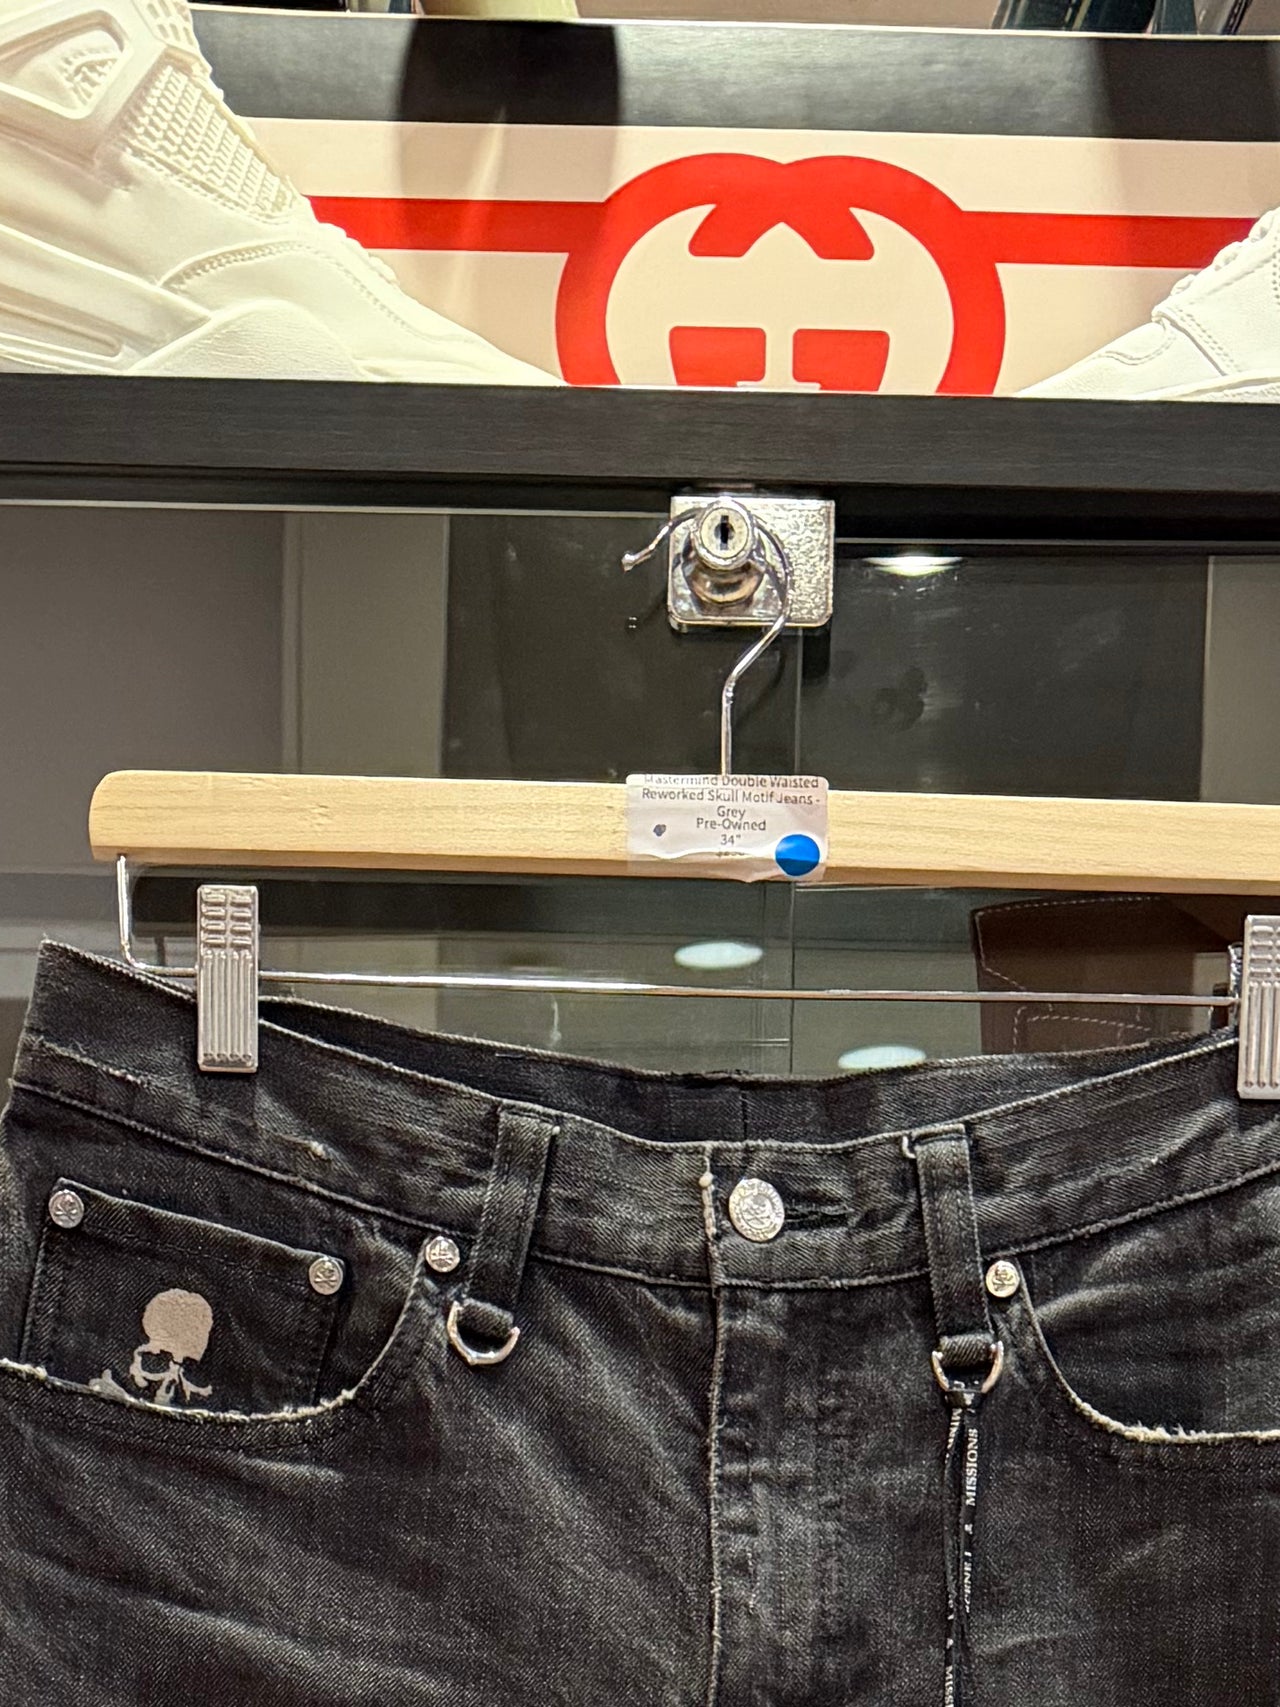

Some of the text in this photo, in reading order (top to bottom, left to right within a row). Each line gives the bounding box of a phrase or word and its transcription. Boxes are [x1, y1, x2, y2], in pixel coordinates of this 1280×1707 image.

[722, 775, 768, 788] Double
[770, 775, 819, 789] Waisted
[642, 787, 704, 800] Reworked
[707, 788, 739, 802] Skull
[742, 790, 775, 803] Motif
[776, 791, 813, 805] Jeans
[716, 805, 746, 820] Grey
[696, 817, 766, 831] Pre-Owned
[965, 1428, 979, 1507] MISSIONS
